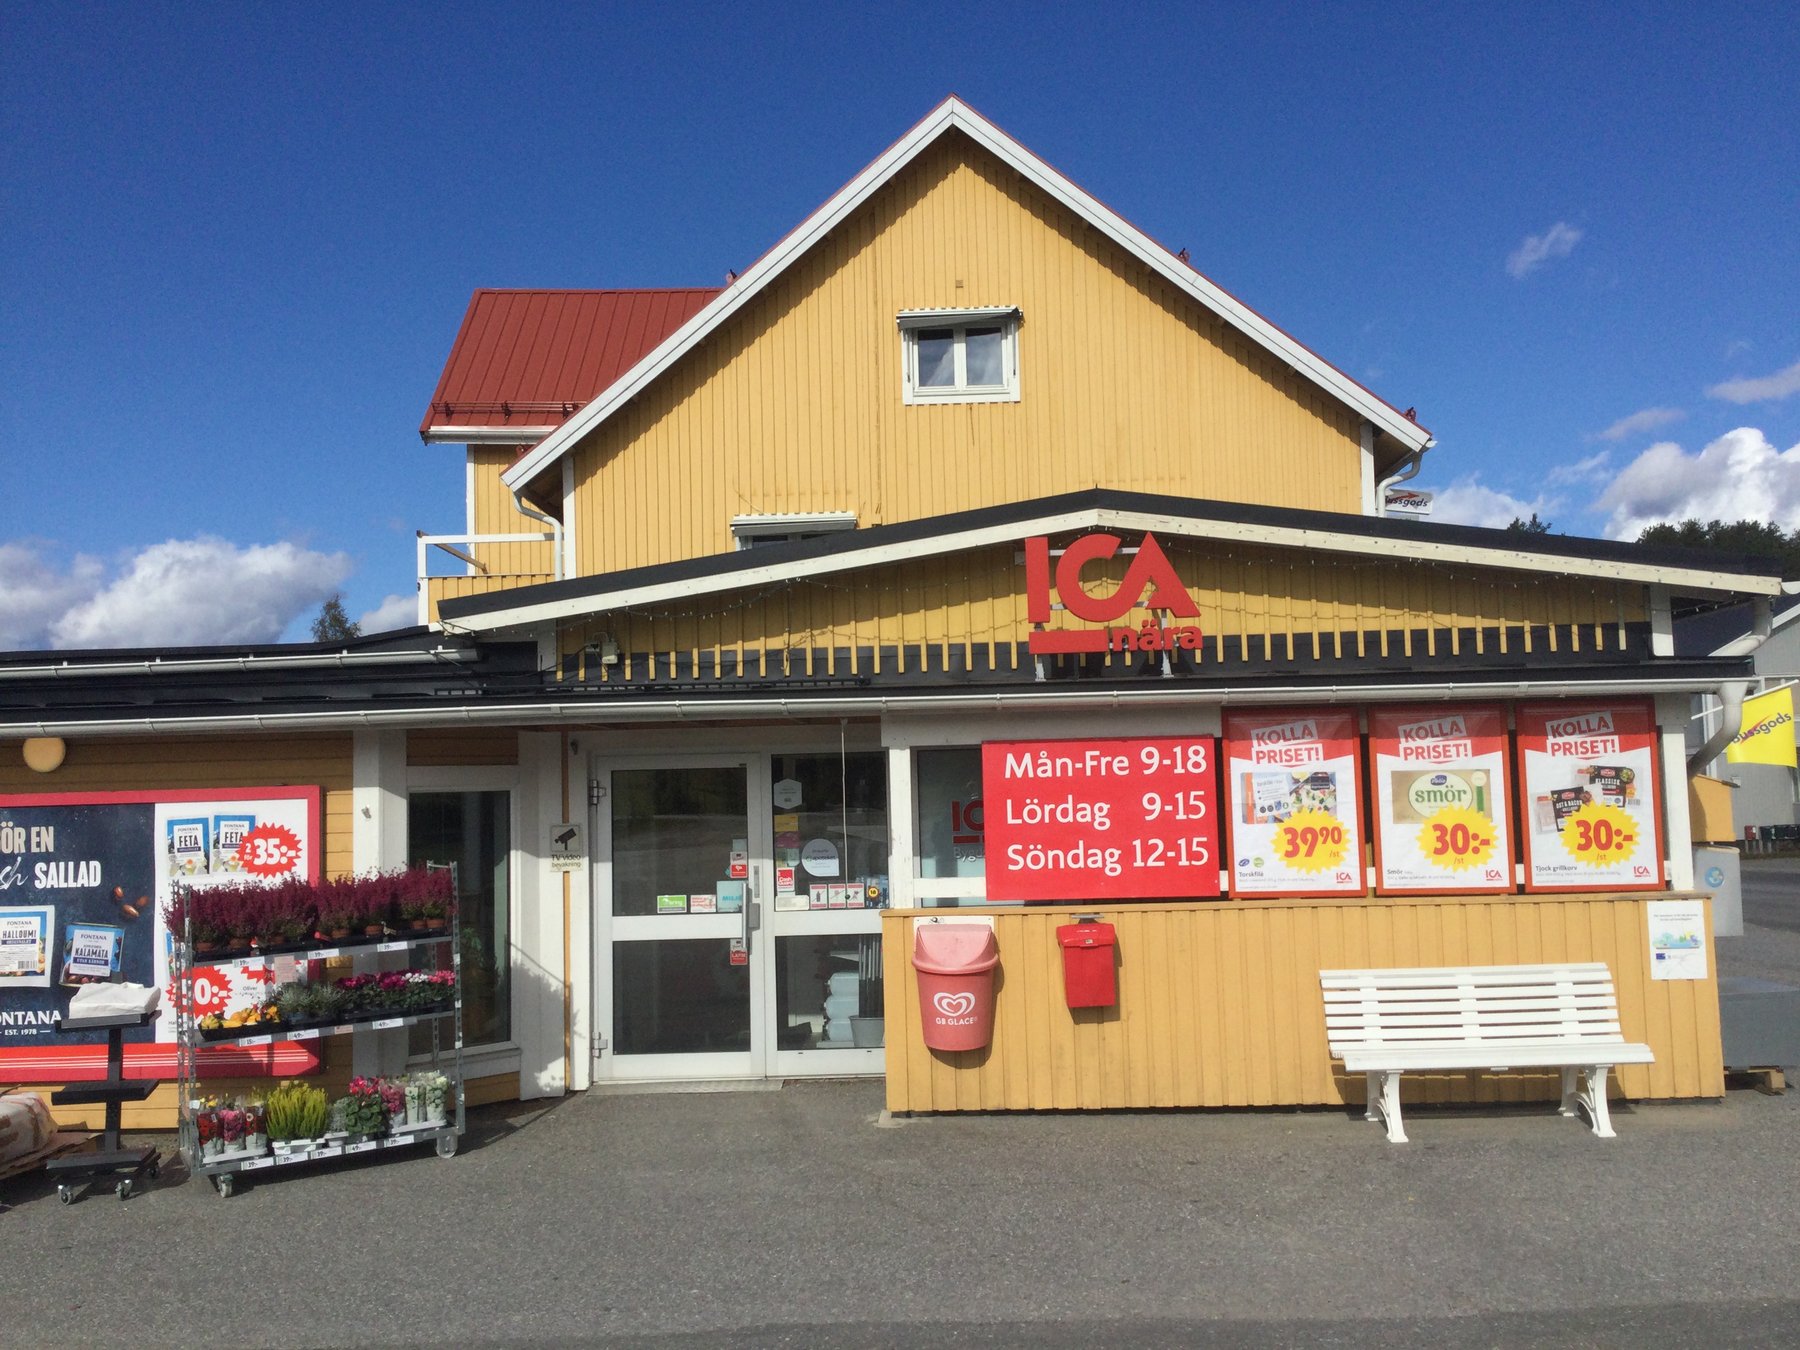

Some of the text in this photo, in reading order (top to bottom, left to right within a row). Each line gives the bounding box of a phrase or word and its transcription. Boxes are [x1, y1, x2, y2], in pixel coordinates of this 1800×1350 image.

[1025, 531, 1201, 623] ICA
[1112, 619, 1203, 651] nära
[1256, 724, 1314, 747] KOLLA
[1403, 720, 1462, 743] KOLLA
[1551, 715, 1610, 738] KOLLA
[1256, 747, 1320, 764] PRISET!
[1403, 743, 1468, 760] PRISET!
[1551, 739, 1616, 756] PRISET!
[1004, 745, 1207, 778] Mån-Fre 9-18
[1415, 785, 1467, 803] smör
[952, 801, 985, 832] IC
[1006, 790, 1206, 831] Lördag 9-15
[31, 826, 54, 853] EN
[179, 834, 199, 847] FETA
[225, 831, 243, 843] FETA
[1432, 823, 1490, 855] 30:-
[1576, 819, 1633, 850] 30:-
[245, 843, 251, 853] 2
[253, 838, 296, 865] 35:-
[1007, 837, 1209, 877] Söndag 12-15
[34, 860, 102, 889] SALLAD
[1336, 872, 1352, 880] ICA
[1486, 870, 1502, 878] ICA
[1633, 866, 1649, 874] ICA
[2, 929, 37, 938] HALLOUMI
[75, 947, 108, 958] KALAMATA
[183, 978, 229, 1005] 0:-
[0, 1010, 62, 1025] NTANA
